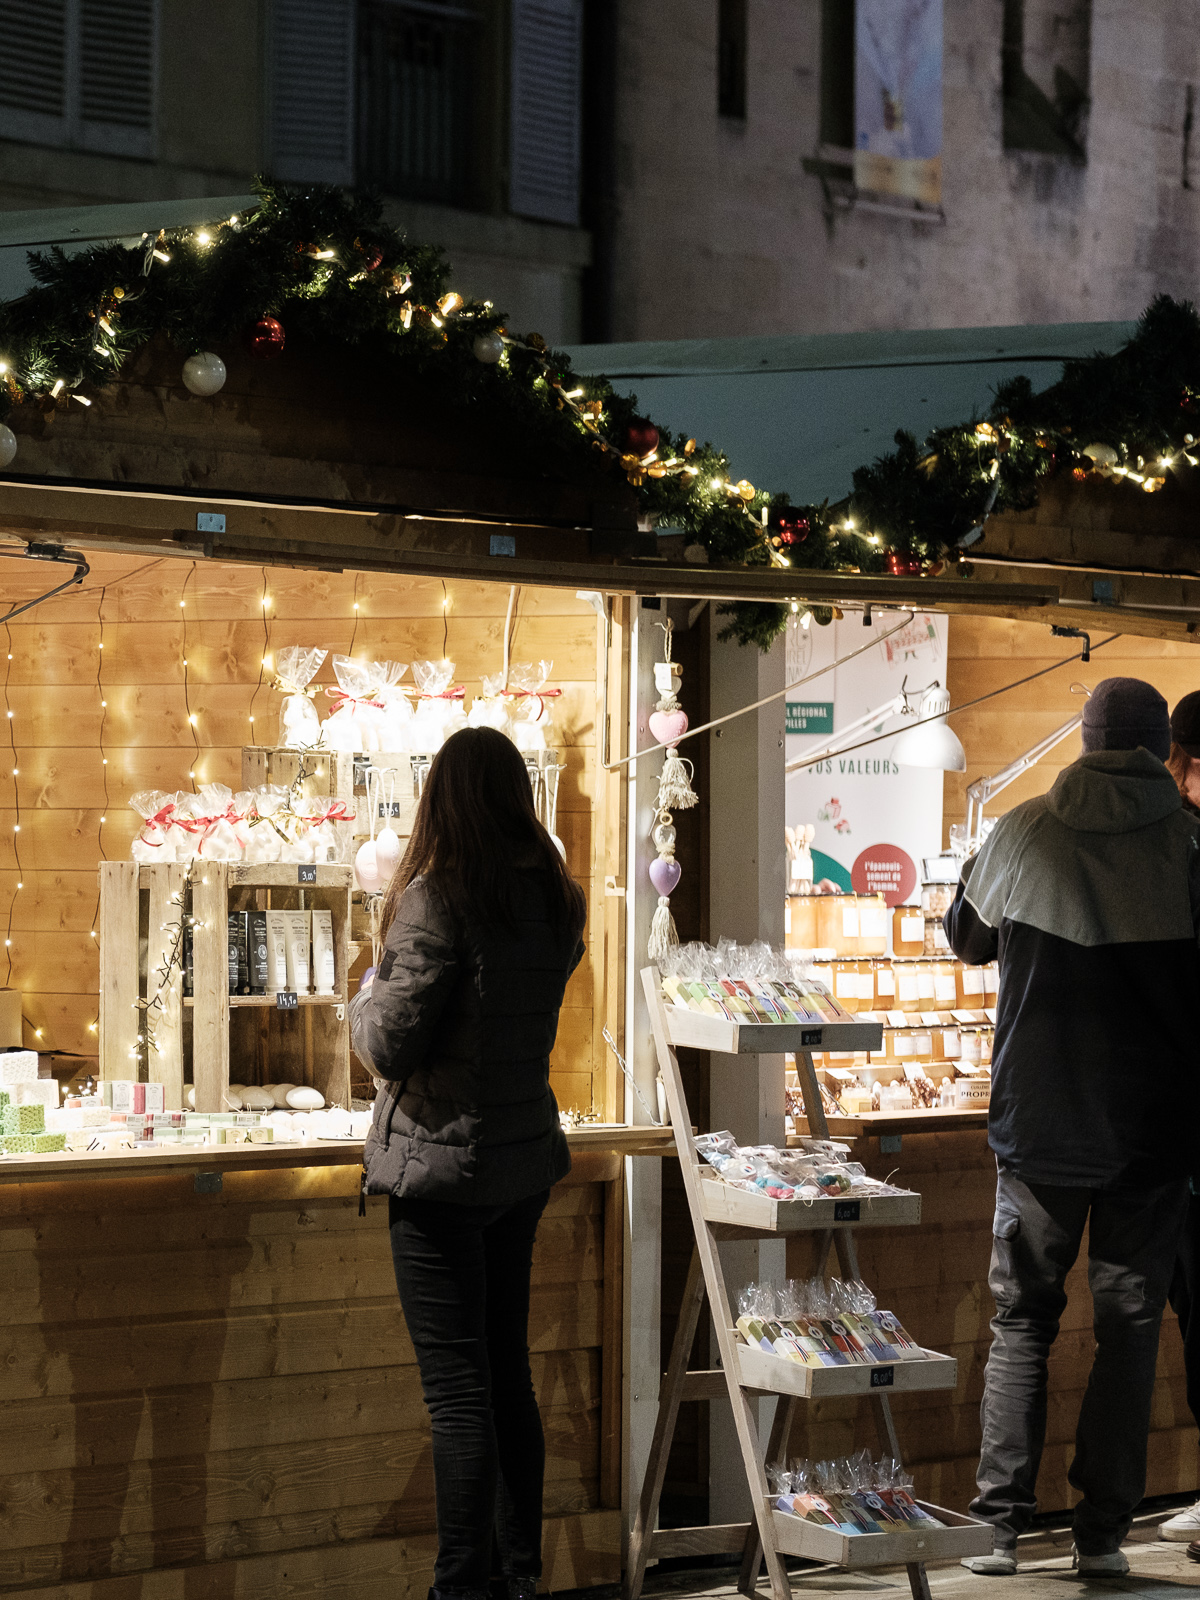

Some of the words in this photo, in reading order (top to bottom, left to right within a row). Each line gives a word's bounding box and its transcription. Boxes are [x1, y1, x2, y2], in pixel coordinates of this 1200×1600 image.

[792, 705, 827, 718] RÉGIONAL
[785, 718, 807, 729] PILLES
[839, 759, 899, 775] VALEURS
[866, 871, 891, 882] sement
[892, 871, 901, 882] de
